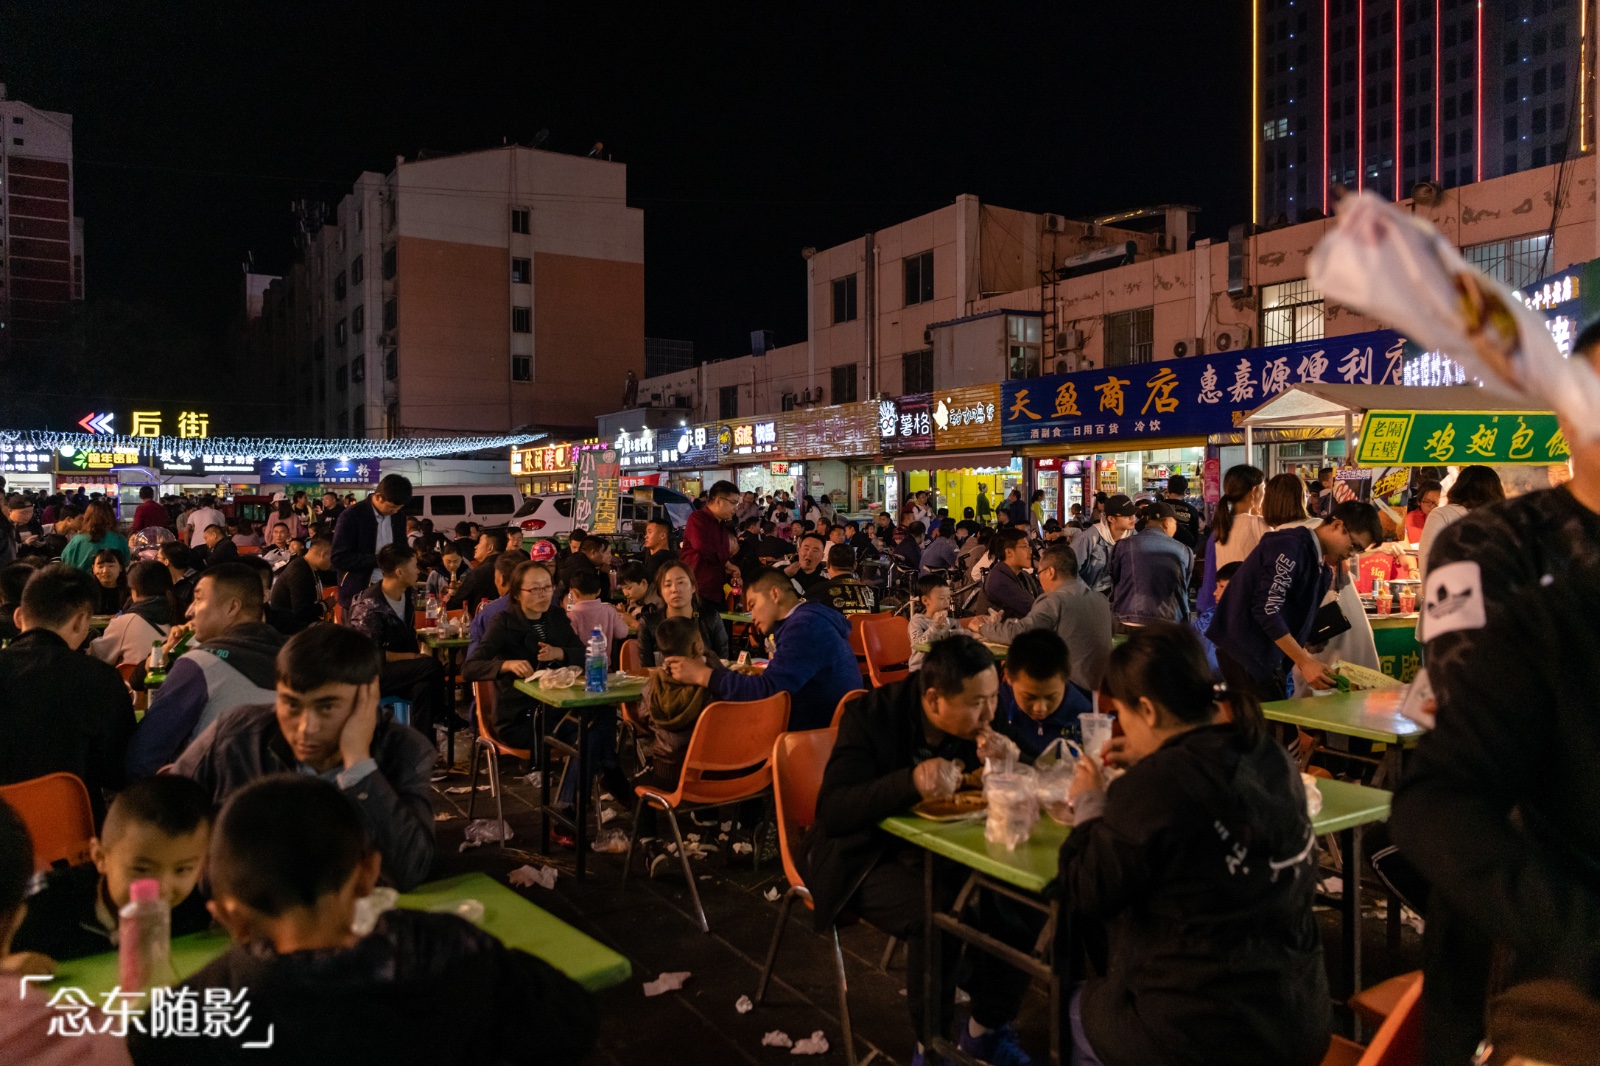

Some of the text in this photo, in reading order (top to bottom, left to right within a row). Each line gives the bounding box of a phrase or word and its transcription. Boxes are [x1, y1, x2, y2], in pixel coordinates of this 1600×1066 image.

[1525, 275, 1575, 311] 十年老店
[1008, 367, 1180, 421] 天盈商店
[130, 411, 209, 439] 后街
[899, 411, 930, 437] 薯格
[1030, 419, 1162, 439] 酒副食 日用百货 冷饮
[1423, 422, 1572, 462] 鸡翅包饭
[270, 461, 371, 478] 天下第一粉
